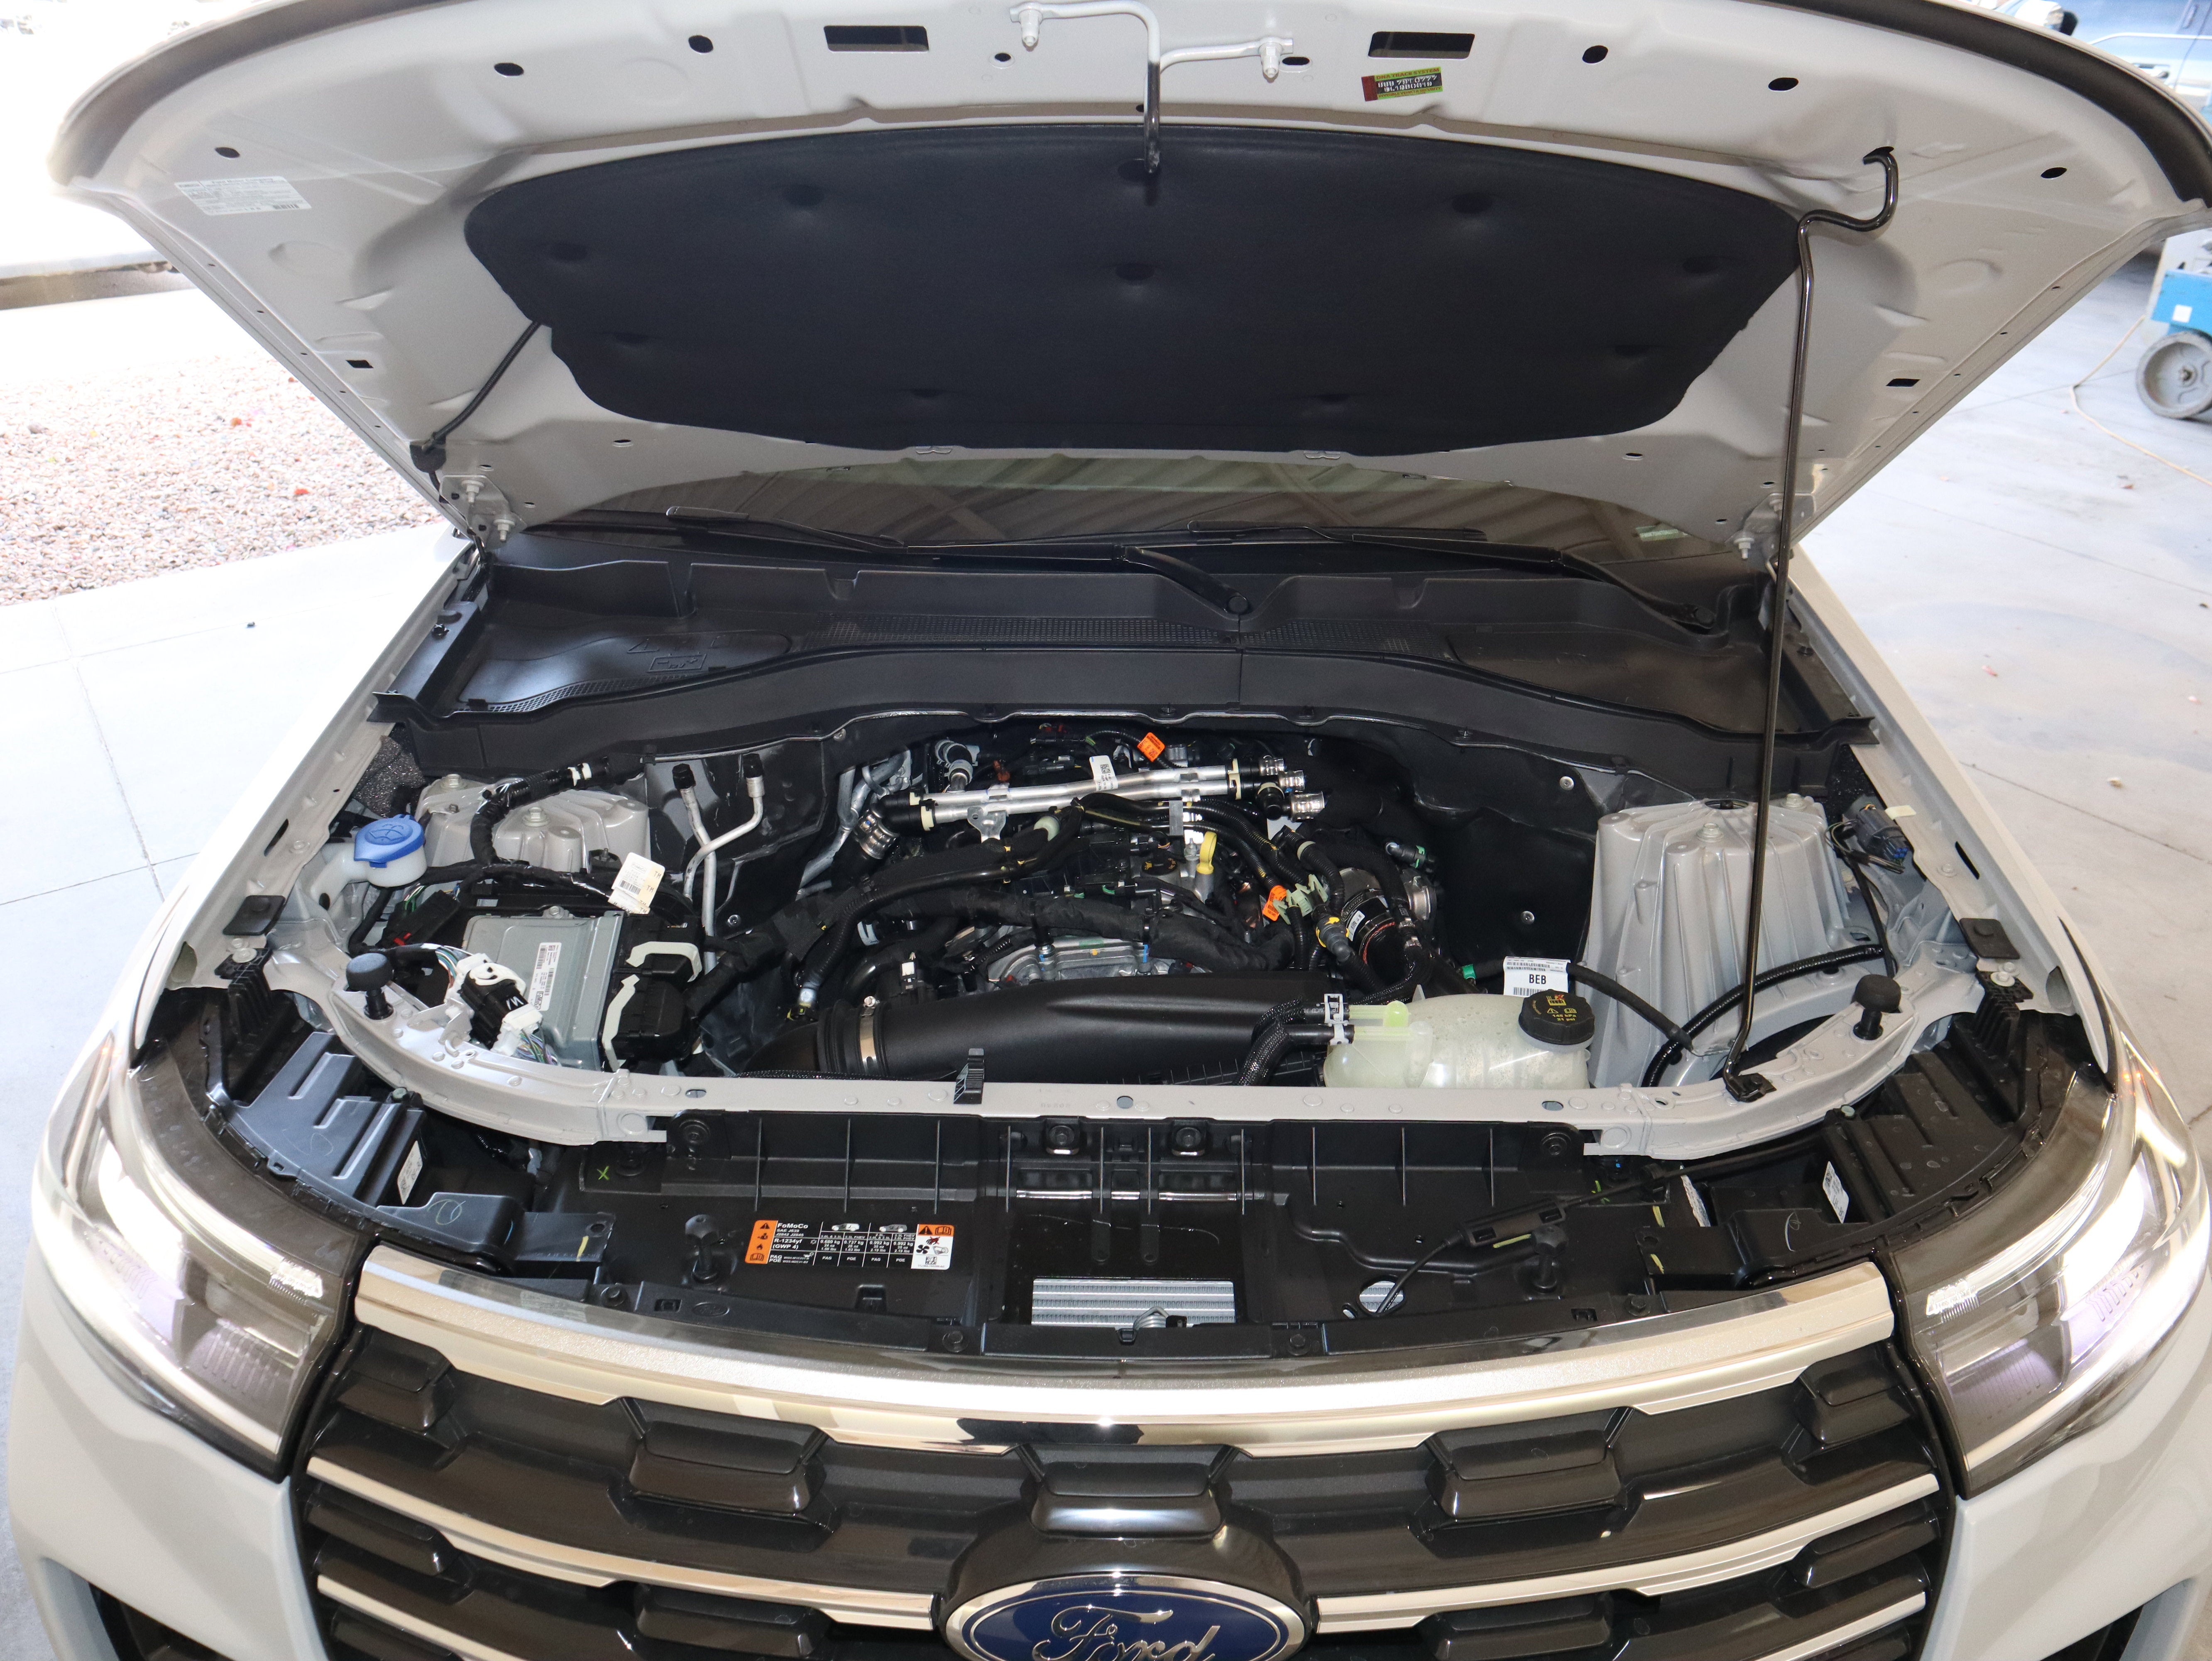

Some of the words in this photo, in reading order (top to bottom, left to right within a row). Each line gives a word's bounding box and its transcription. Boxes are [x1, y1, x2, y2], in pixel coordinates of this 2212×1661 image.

[653, 871, 662, 879] TM
[1529, 974, 1546, 984] BEB
[534, 992, 543, 1009] FoMoCo
